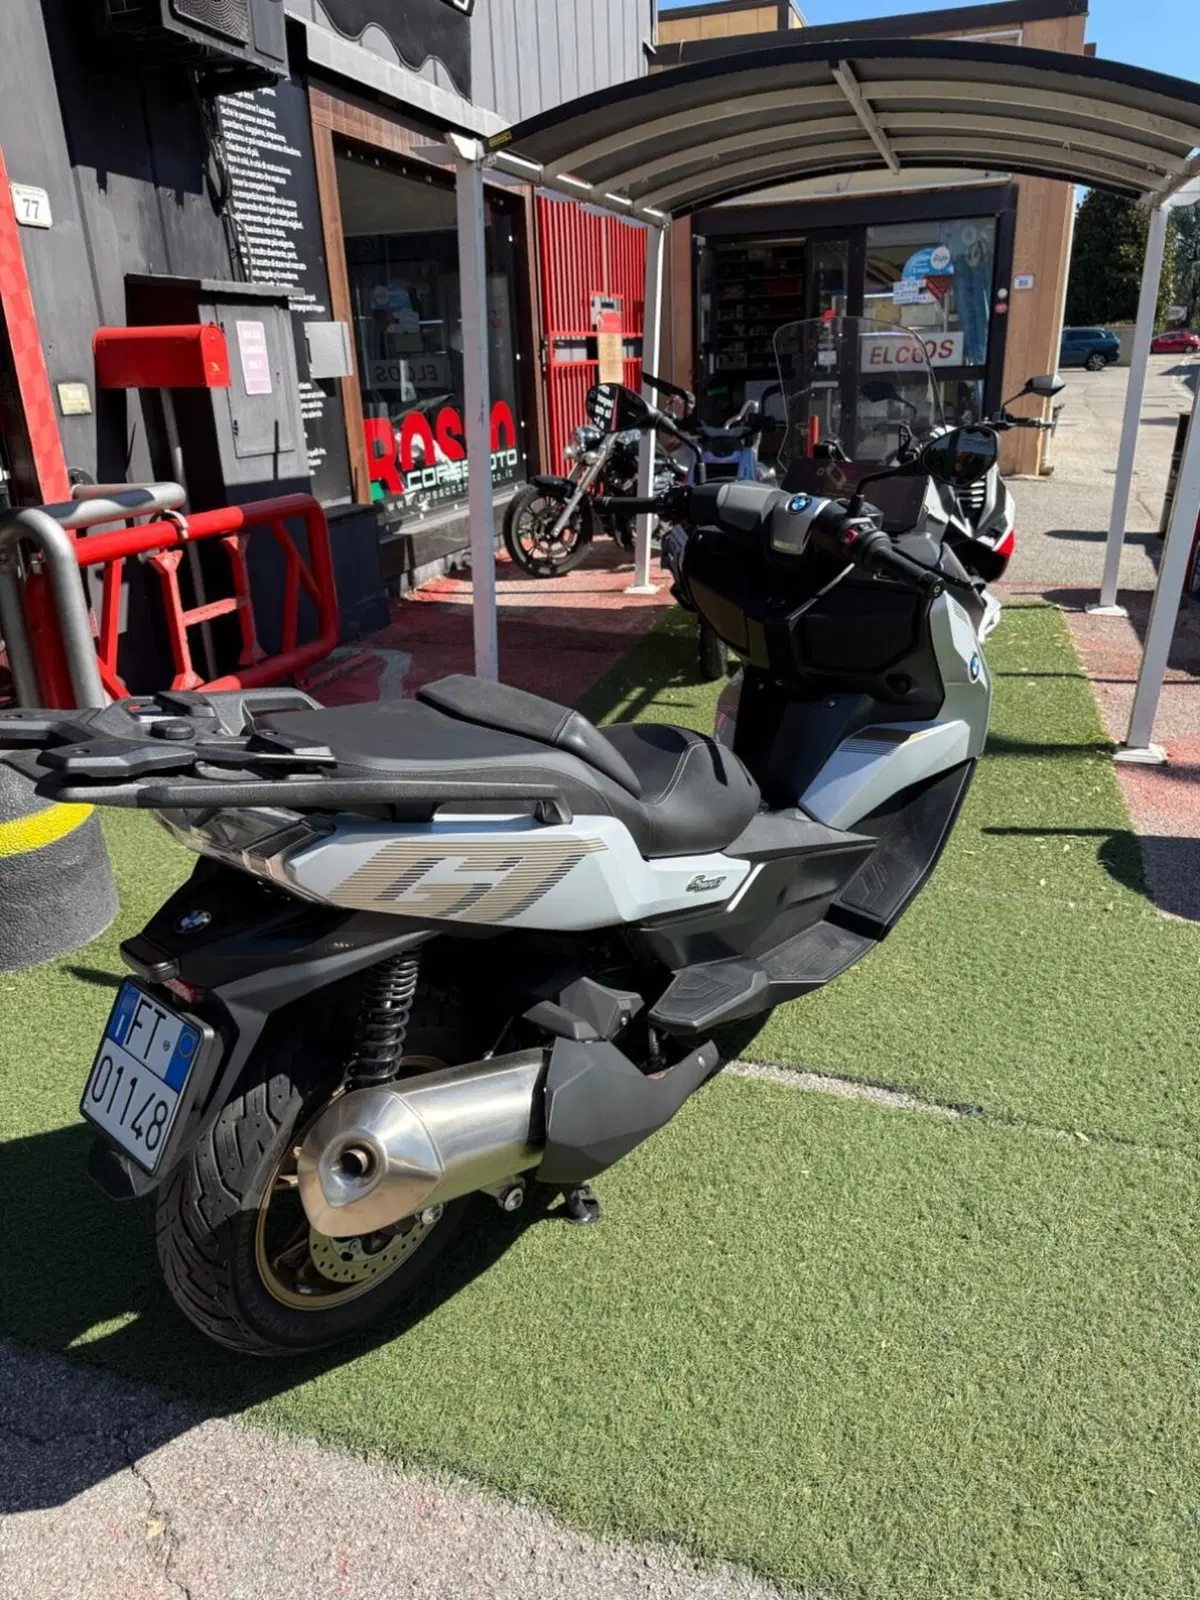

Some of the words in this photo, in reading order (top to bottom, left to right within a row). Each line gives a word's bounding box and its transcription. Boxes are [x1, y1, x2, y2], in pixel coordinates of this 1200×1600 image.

[22, 198, 39, 219] 77
[363, 401, 516, 495] ROSO
[404, 448, 518, 493] CORSEOTO
[125, 997, 166, 1060] FT
[91, 1055, 168, 1151] 01148
